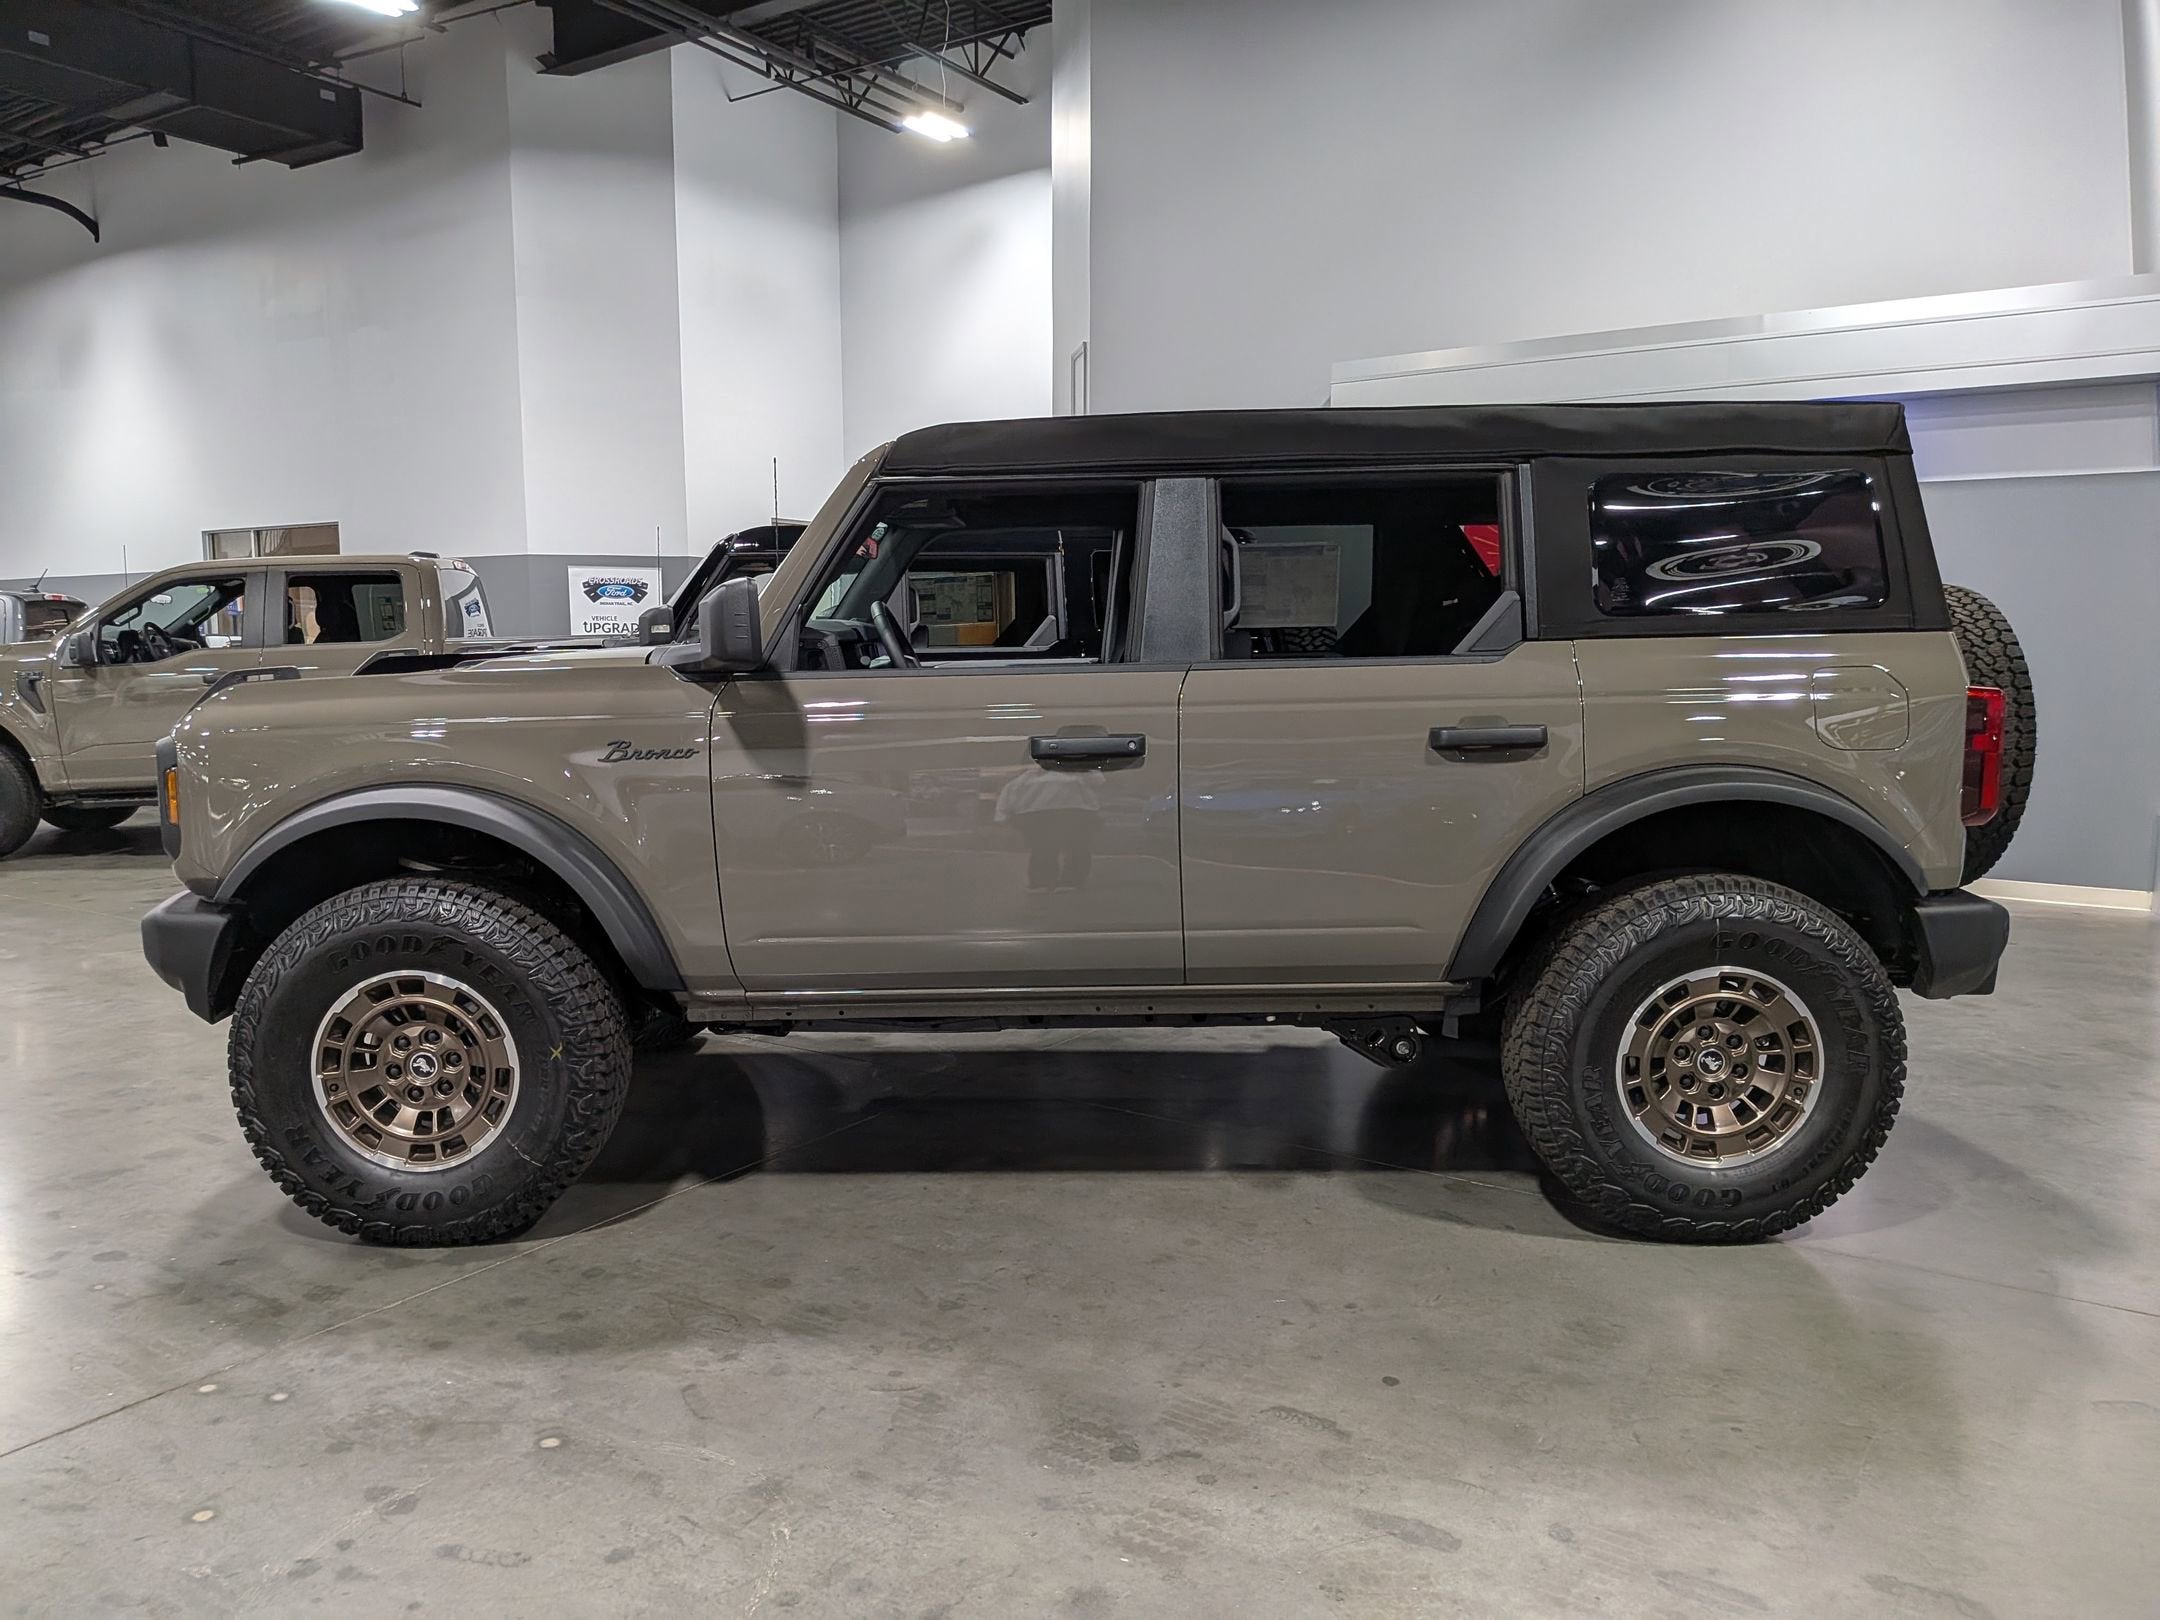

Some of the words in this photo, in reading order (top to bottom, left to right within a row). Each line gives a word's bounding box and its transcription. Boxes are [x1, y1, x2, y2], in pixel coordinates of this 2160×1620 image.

[587, 577, 643, 586] CROSSROADS
[604, 587, 628, 597] Ford
[583, 621, 640, 634] UPGRAD
[597, 740, 700, 763] Bronco
